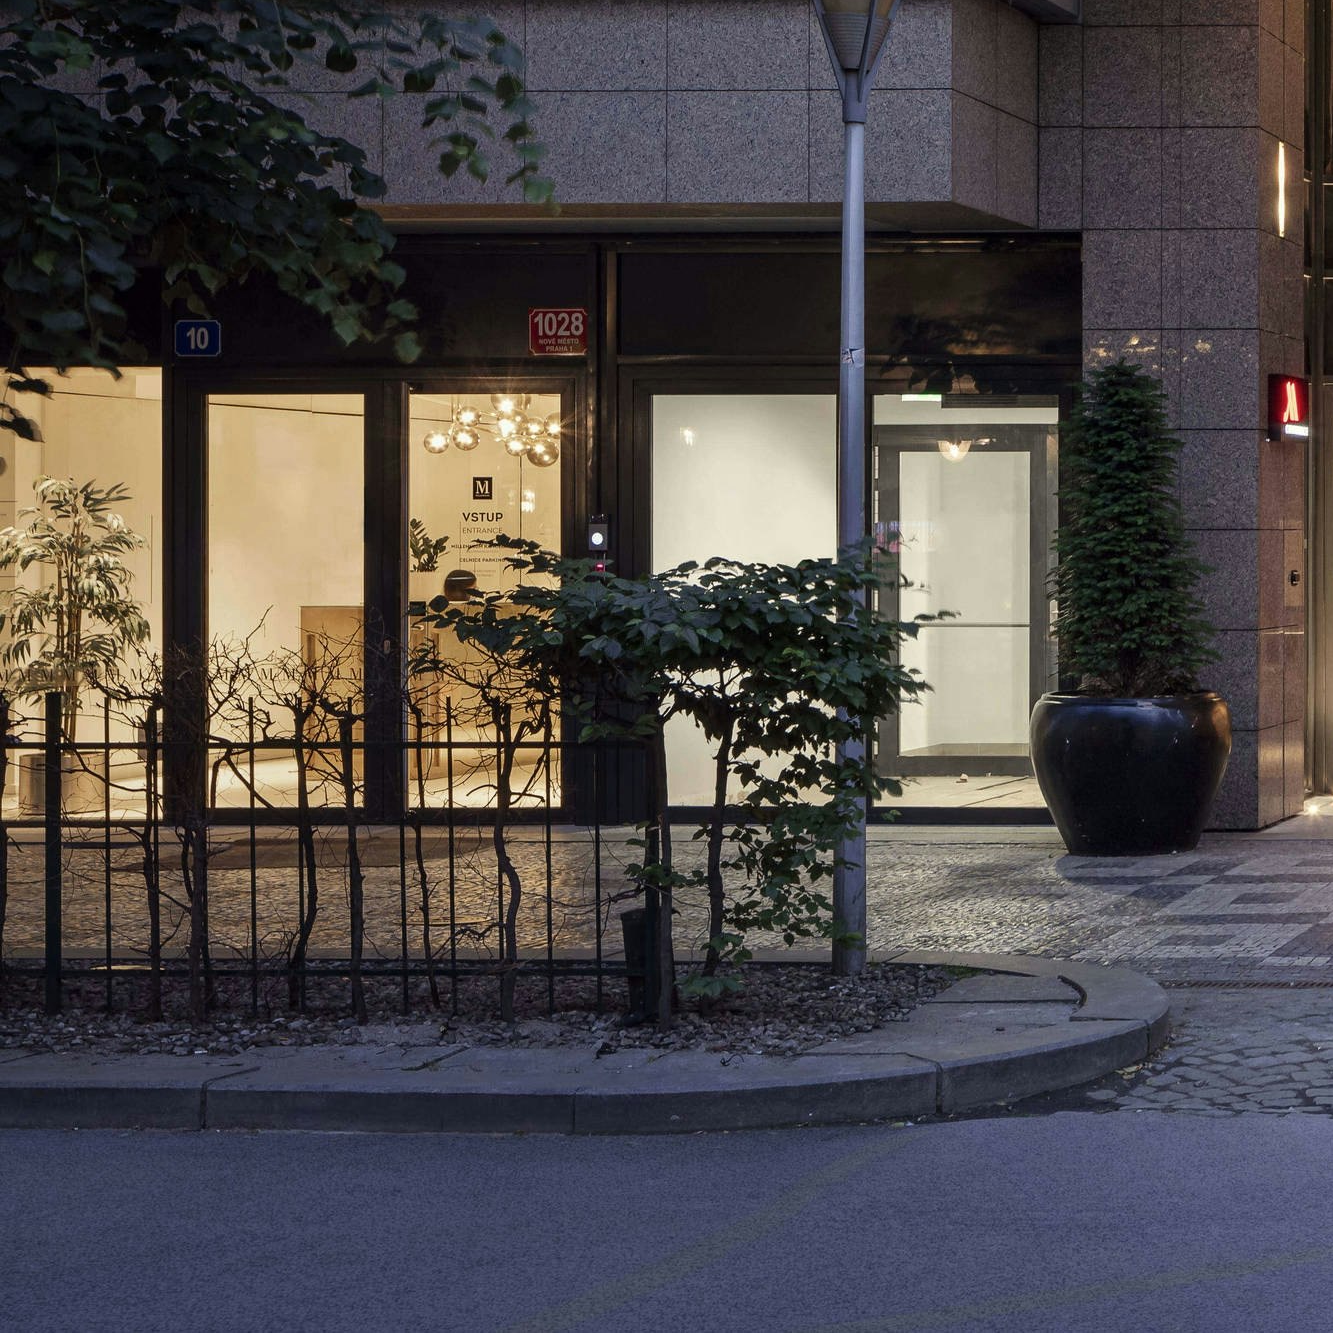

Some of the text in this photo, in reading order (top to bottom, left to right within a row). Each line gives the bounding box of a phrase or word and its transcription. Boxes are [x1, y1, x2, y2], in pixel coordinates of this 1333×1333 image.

[533, 312, 584, 336] 1028
[187, 327, 209, 349] 10
[538, 337, 556, 345] NOVÉ
[475, 481, 490, 494] M
[462, 512, 503, 522] VSTUP
